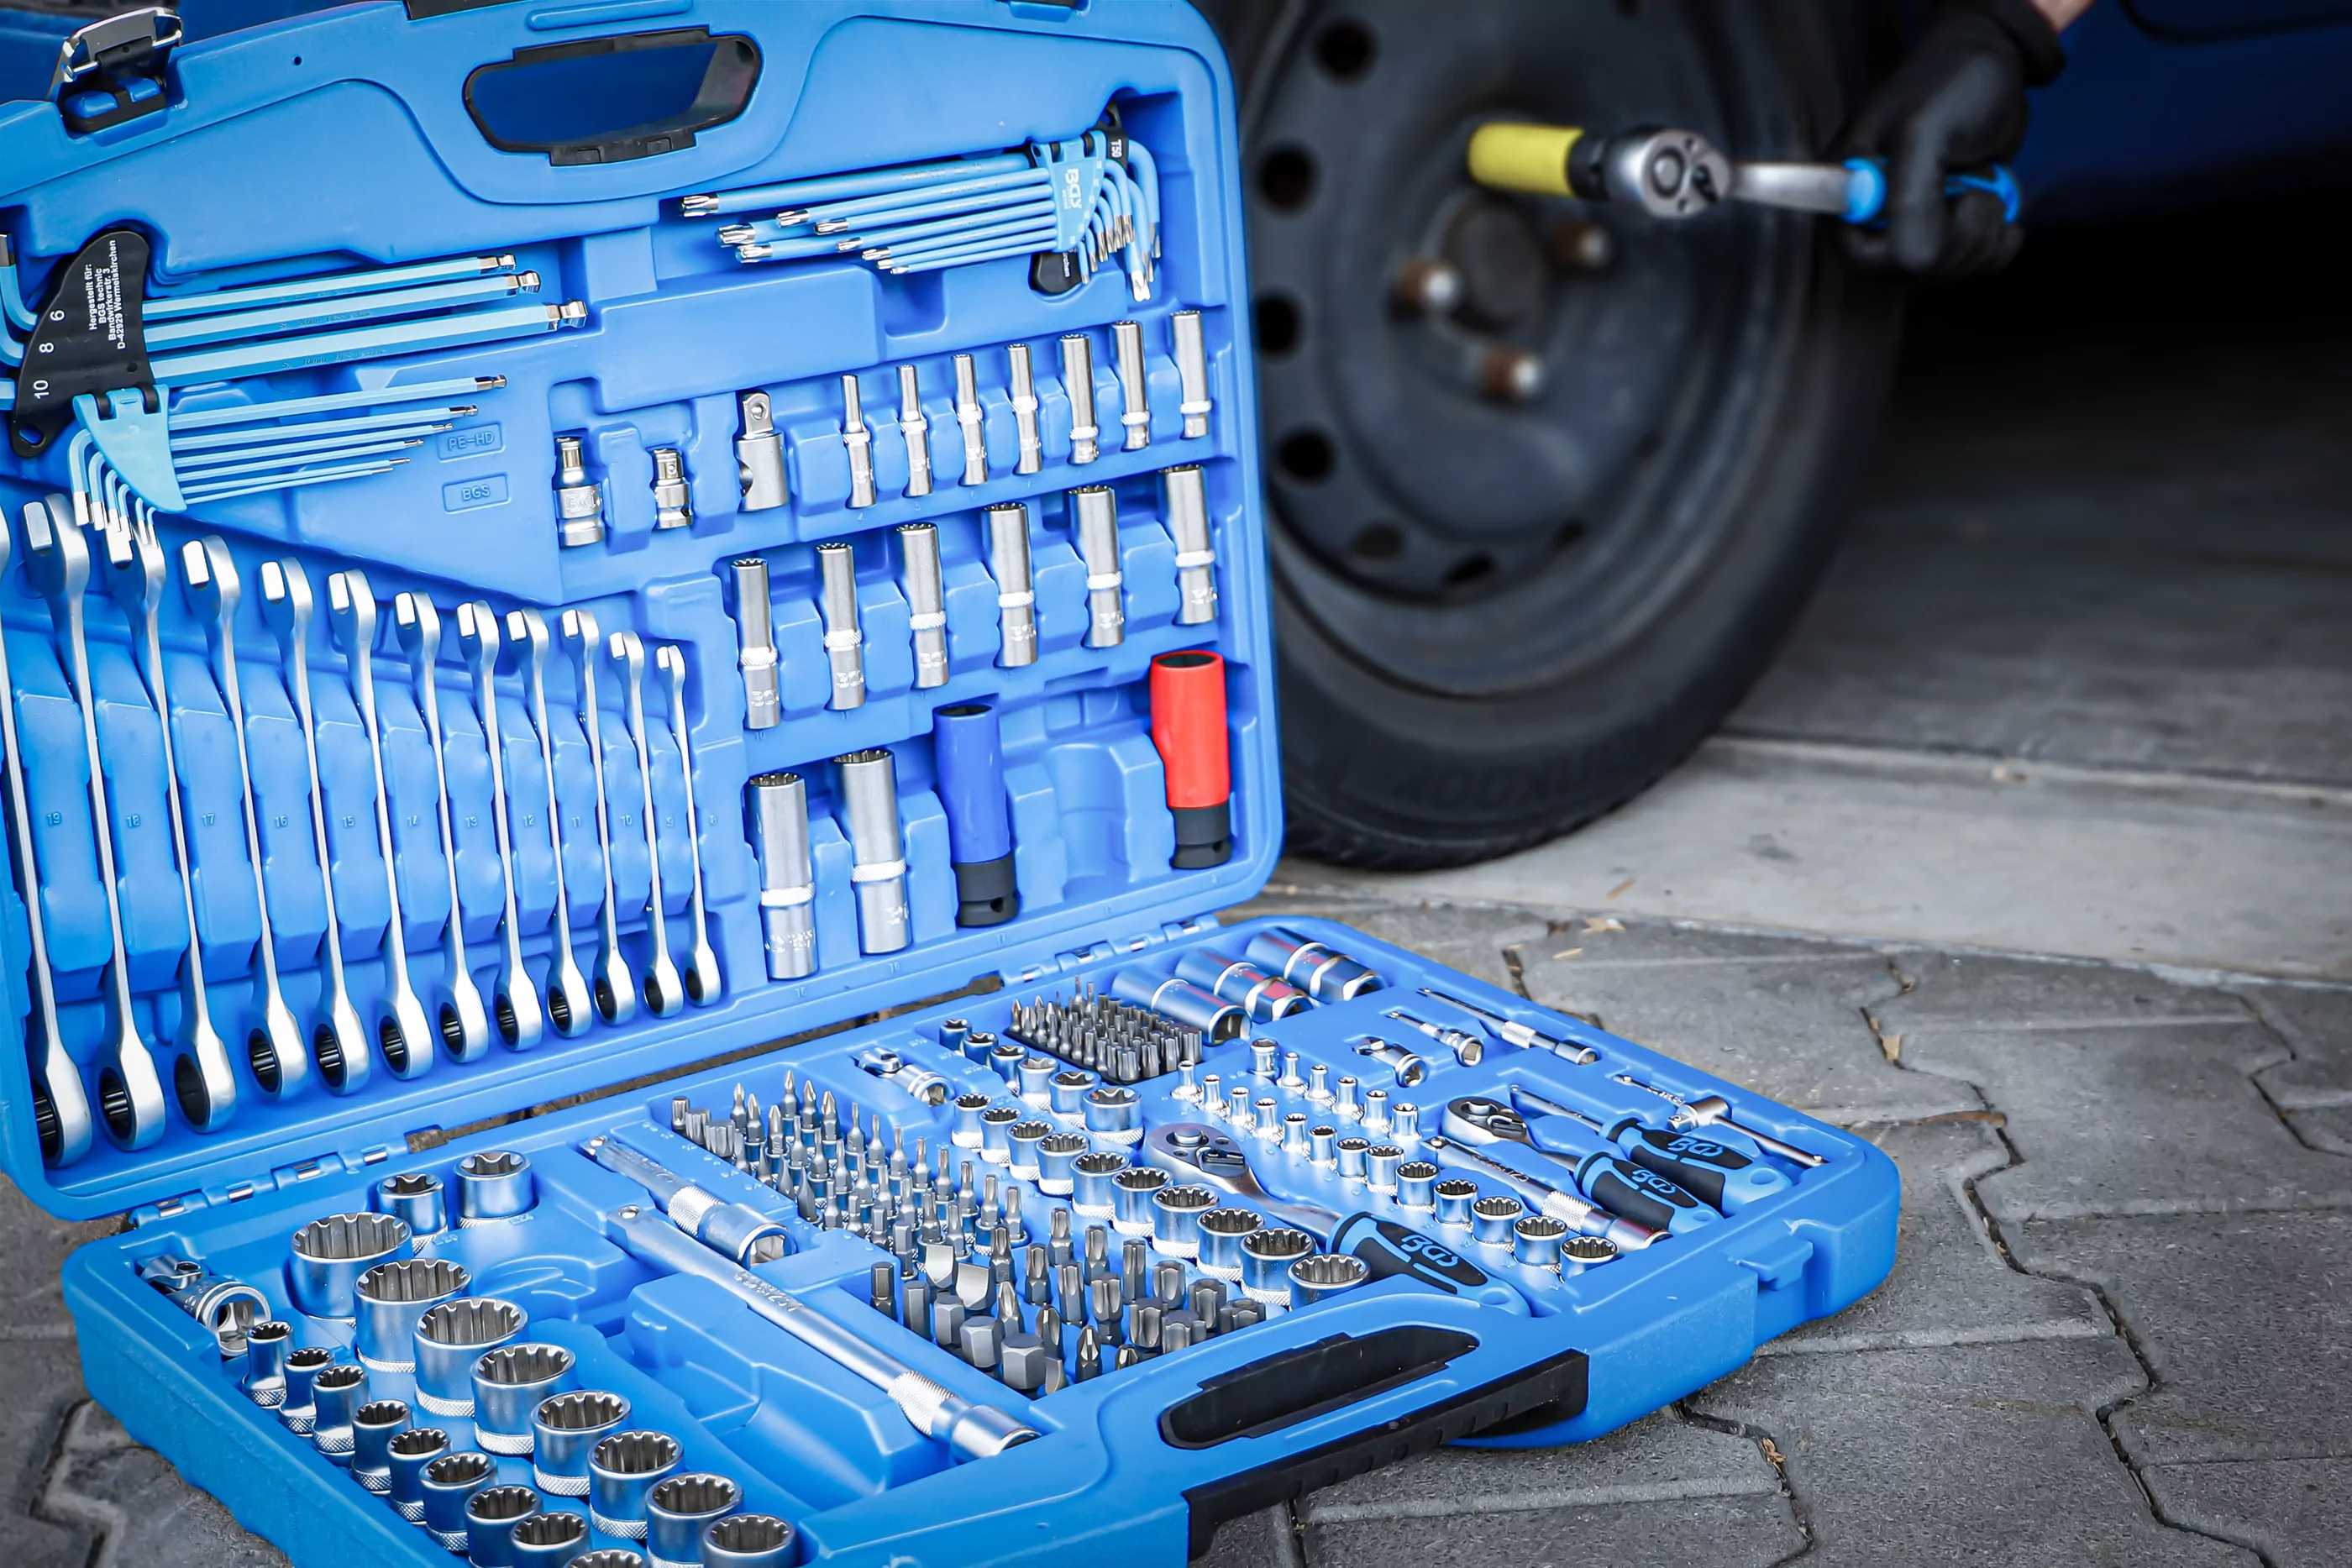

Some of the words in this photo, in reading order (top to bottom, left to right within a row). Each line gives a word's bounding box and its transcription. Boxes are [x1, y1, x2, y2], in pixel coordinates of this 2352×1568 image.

[1110, 139, 1122, 158] T50
[1065, 168, 1082, 208] BGS
[84, 263, 92, 281] für:
[109, 239, 122, 312] Wermelskirchen
[95, 267, 105, 302] technic
[50, 309, 65, 321] 6
[86, 281, 97, 331] Hergestellt
[97, 302, 107, 324] BGS
[104, 275, 117, 341] Bandwirkerstr.
[115, 312, 126, 349] D-42929
[39, 342, 55, 354] 8
[33, 379, 50, 400] 10
[447, 431, 495, 452] PE-HD
[461, 484, 491, 502] BGS
[564, 488, 601, 513] BG
[47, 811, 61, 826] 19
[125, 814, 140, 827] 18
[202, 813, 216, 826] 17
[274, 815, 288, 828] 16
[342, 815, 355, 829] 15
[522, 814, 535, 828] 12
[570, 816, 582, 829] 11
[620, 815, 633, 827] 10
[666, 816, 675, 828] 9
[707, 814, 717, 826] 8
[1667, 1136, 1724, 1157] BGS
[1631, 1169, 1677, 1194] BGS
[1400, 1235, 1458, 1267] BGS
